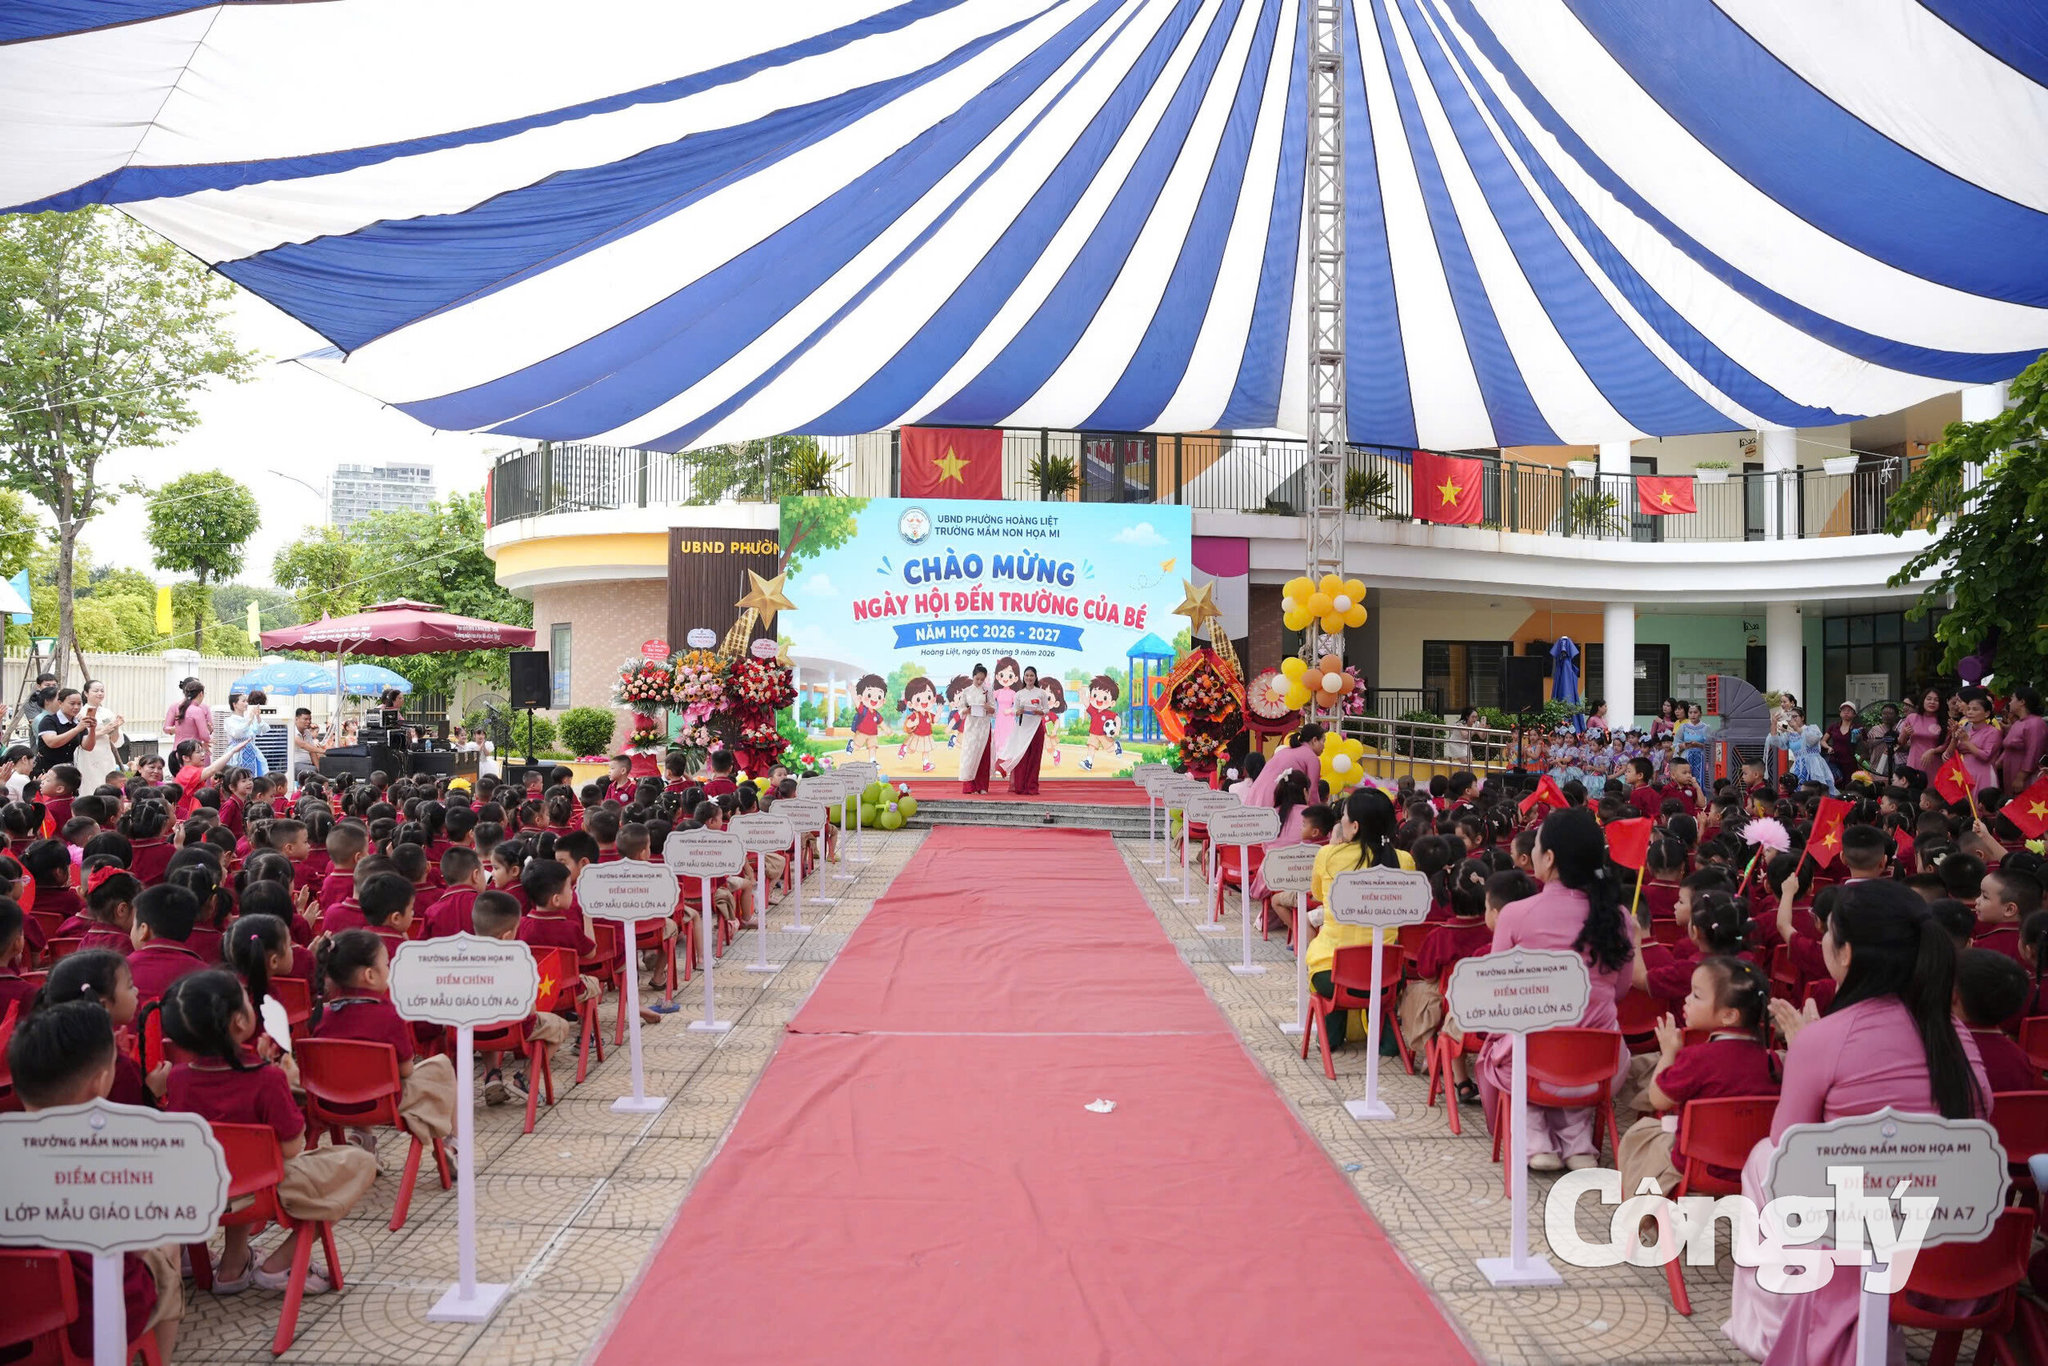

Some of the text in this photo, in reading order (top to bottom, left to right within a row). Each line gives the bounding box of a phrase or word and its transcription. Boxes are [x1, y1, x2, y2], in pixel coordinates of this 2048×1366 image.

[938, 514, 1059, 527] UBND PHƯỜNG HOÀNG LIỆT
[935, 525, 974, 536] TRƯỜNG
[1002, 528, 1023, 537] NON
[1026, 529, 1046, 540] HỌA
[1049, 529, 1060, 538] MI
[681, 538, 779, 555] UBND PHƯỜN
[904, 547, 1075, 586] CHÀO MỪNG
[853, 583, 1147, 630] NGÀY HỘI ĐẾN TRƯỜNG CỦA BÉ
[916, 625, 946, 641] NĂM
[951, 625, 978, 642] HỌC
[983, 625, 1015, 639] 2026
[1029, 627, 1060, 642] 2027
[605, 898, 621, 908] MẪU
[436, 973, 494, 985] ĐIỂM CHÍNH
[1476, 968, 1506, 977] TRƯỜNG
[1543, 966, 1558, 974] HỌA
[1494, 984, 1549, 997] ĐIỂM CHÍNH
[408, 995, 428, 1006] LỚP
[431, 993, 452, 1006] MẪU
[456, 996, 479, 1006] GIÁO
[482, 995, 502, 1006] LỚN
[1467, 1003, 1572, 1019] LỚP MẪU GIÁO LỚN A5
[22, 1134, 76, 1148] TRƯỜNG
[112, 1138, 138, 1147] NON
[142, 1138, 167, 1150] HỌA
[171, 1138, 185, 1148] MI
[1817, 1144, 1866, 1156] TRƯỜNG
[1901, 1145, 1926, 1154] NON
[1929, 1144, 1953, 1156] HỌA
[1957, 1144, 1971, 1152] MI
[54, 1166, 153, 1184] ĐIỂM CHÍNH
[5, 1198, 197, 1222] LỚP MẪU GIÁO LỚN A8
[1954, 1207, 1974, 1220] A7
